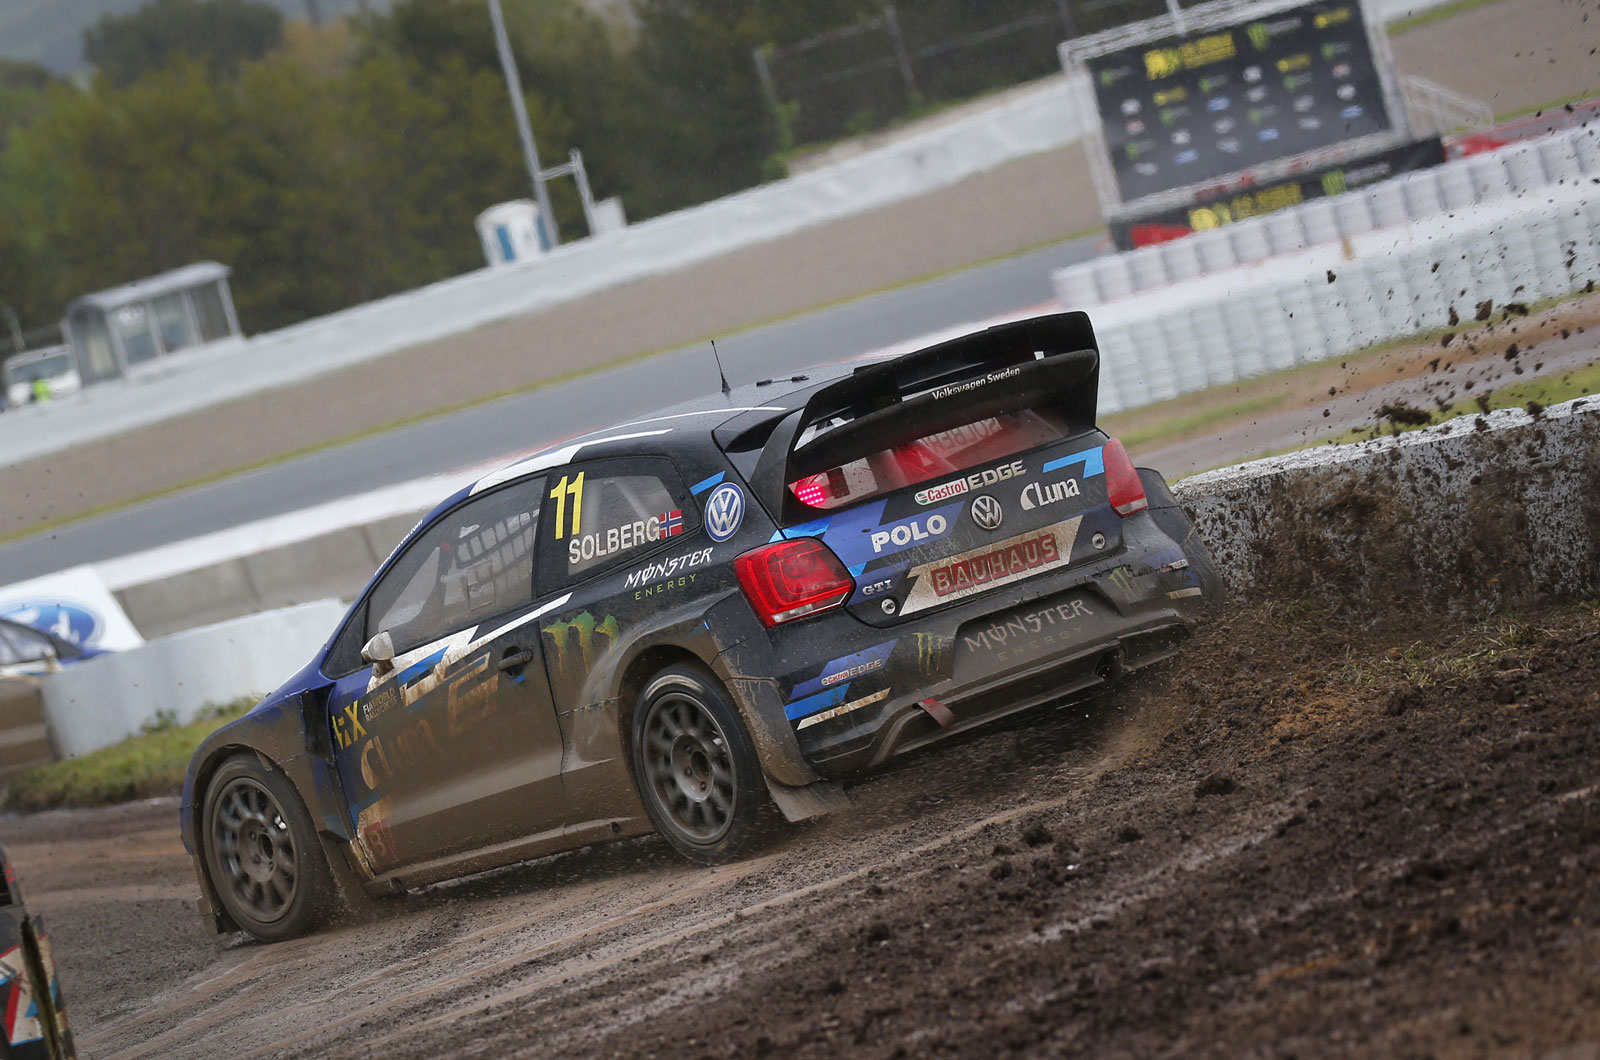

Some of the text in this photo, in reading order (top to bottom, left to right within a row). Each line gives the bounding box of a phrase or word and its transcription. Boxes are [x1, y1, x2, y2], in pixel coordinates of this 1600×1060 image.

[932, 367, 1020, 400] Volkswagen Sweden
[927, 459, 1027, 502] Castrol EDGE
[550, 471, 585, 540] 11
[568, 516, 660, 564] SOLBERG
[871, 514, 947, 553] POLO
[934, 535, 1059, 594] BAUHAUS
[635, 573, 697, 600] ENERGY
[862, 579, 893, 596] GTI
[849, 658, 882, 677] EDGE
